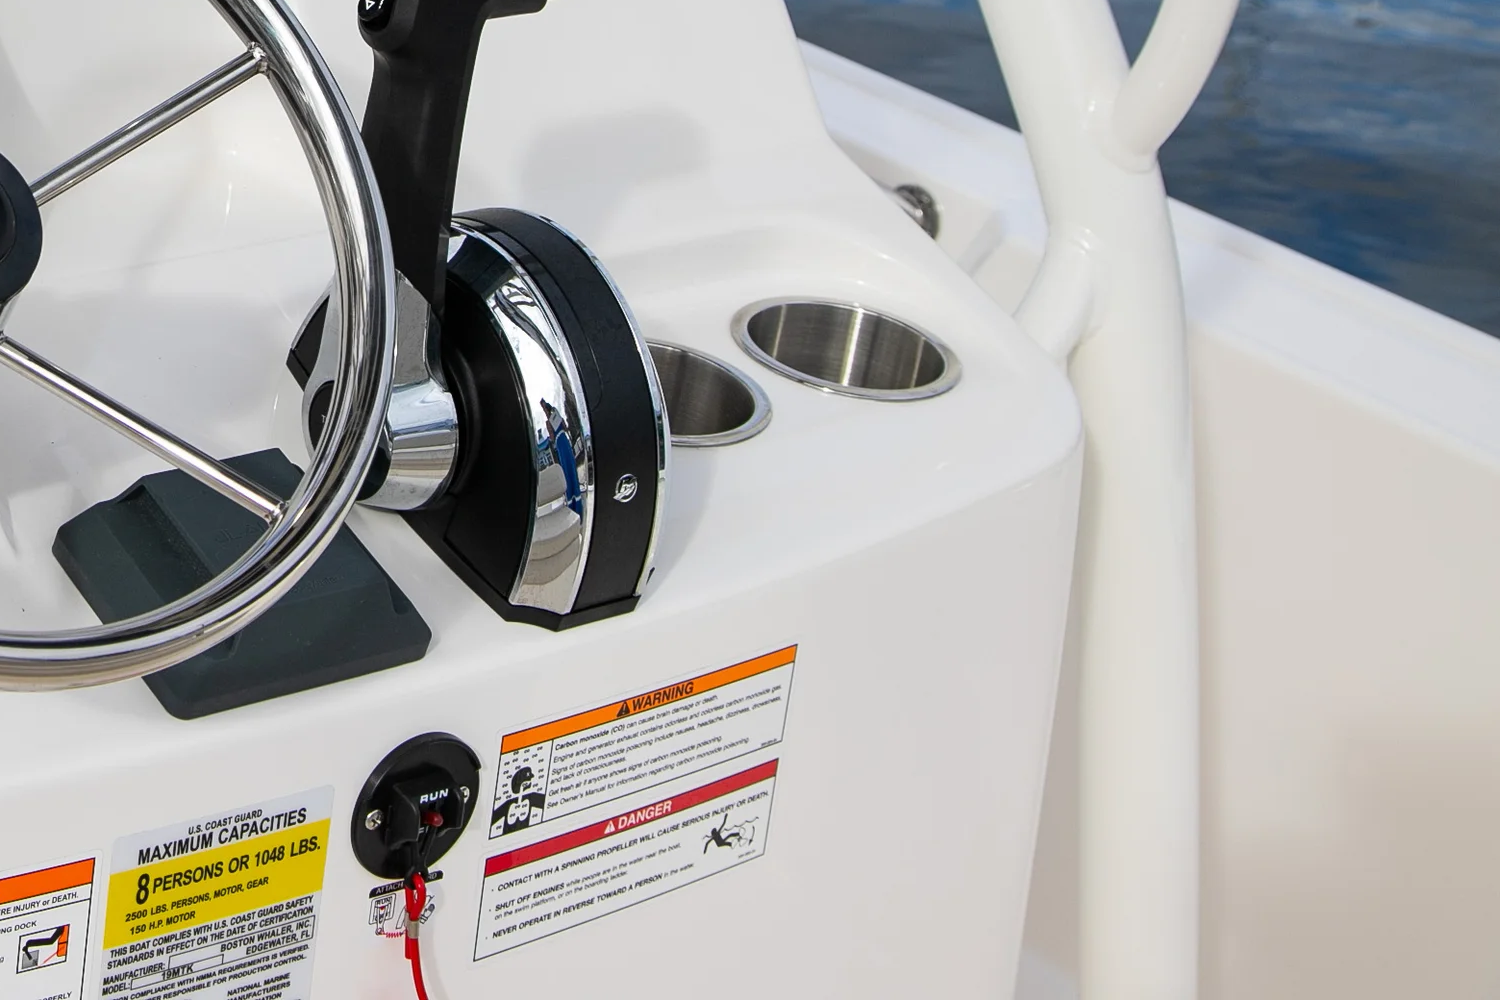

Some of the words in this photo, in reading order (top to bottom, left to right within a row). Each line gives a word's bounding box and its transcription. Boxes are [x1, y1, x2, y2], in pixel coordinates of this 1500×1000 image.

[630, 680, 694, 712] WARNING
[554, 738, 578, 751] Carbon
[579, 728, 609, 743] monoxide
[610, 723, 625, 734] (CO)
[420, 788, 449, 804] RUN
[187, 823, 202, 835] U.S.
[204, 816, 232, 830] COAST
[234, 808, 262, 823] GUARD
[617, 799, 672, 829] DANGER
[137, 830, 213, 865] MAXIMUM
[217, 806, 307, 844] CAPACITIES
[497, 874, 532, 892] CONTACT
[533, 867, 552, 879] WITH
[561, 852, 595, 870] SPINNING
[596, 837, 637, 858] PROPELLER
[639, 831, 654, 843] WILL
[657, 823, 679, 836] CAUSE
[681, 811, 710, 828] SERIOUS
[711, 803, 733, 817] INJURY
[736, 798, 745, 808] OR
[747, 789, 769, 804] DEATH.
[135, 871, 151, 906] 8
[152, 860, 223, 894] PERSONS
[227, 853, 249, 874] OR
[254, 844, 285, 867] 1048
[289, 834, 321, 857] LBS.
[13, 900, 40, 912] INJURY
[51, 891, 79, 903] DEATH.
[124, 908, 147, 922] 2500
[150, 903, 168, 915] LBS.
[170, 891, 211, 910] PERSONS,
[213, 883, 244, 899] MOTOR,
[246, 876, 269, 889] GEAR
[376, 881, 404, 894] ATTACH
[494, 899, 514, 912] SHUT
[516, 894, 530, 904] OFF
[532, 882, 564, 899] ENGINES
[491, 924, 516, 939] NEVER
[518, 912, 551, 930] OPERATE
[553, 908, 561, 917] IN
[562, 897, 594, 914] REVERSE
[596, 885, 626, 902] TOWARD
[634, 872, 662, 888] PERSON
[14, 920, 37, 931] DOCK
[106, 949, 154, 970] STANDARDS
[156, 947, 164, 956] IN
[165, 938, 195, 954] EFFECT
[196, 935, 208, 945] ON
[209, 930, 224, 941] THE
[226, 924, 245, 937] DATE
[247, 921, 257, 931] OF
[259, 905, 313, 927] CERTIFICATION
[109, 946, 127, 958] THIS
[129, 940, 150, 953] BOAT
[152, 928, 191, 947] COMPLIES
[192, 923, 212, 936] WITH
[213, 919, 227, 930] U.S.
[230, 911, 255, 925] COAST
[257, 903, 284, 917] GUARD
[285, 894, 313, 910] SAFETY
[129, 923, 146, 935] 150
[148, 919, 163, 930] H.P.
[165, 910, 195, 925] MOTOR
[219, 935, 255, 952] BOSTON
[256, 923, 293, 942] WHALER,
[295, 918, 312, 930] INC.
[245, 932, 298, 955] EDGEWATER,
[300, 929, 310, 939] FL
[102, 960, 166, 986] MANUFACTURER:
[130, 982, 175, 1000] COMPLIANCE
[177, 977, 194, 987] WITH
[195, 970, 216, 981] NMMA
[217, 955, 269, 975] REQUIREMENTS
[160, 963, 194, 981] 19MTK
[101, 980, 130, 996] MODEL:
